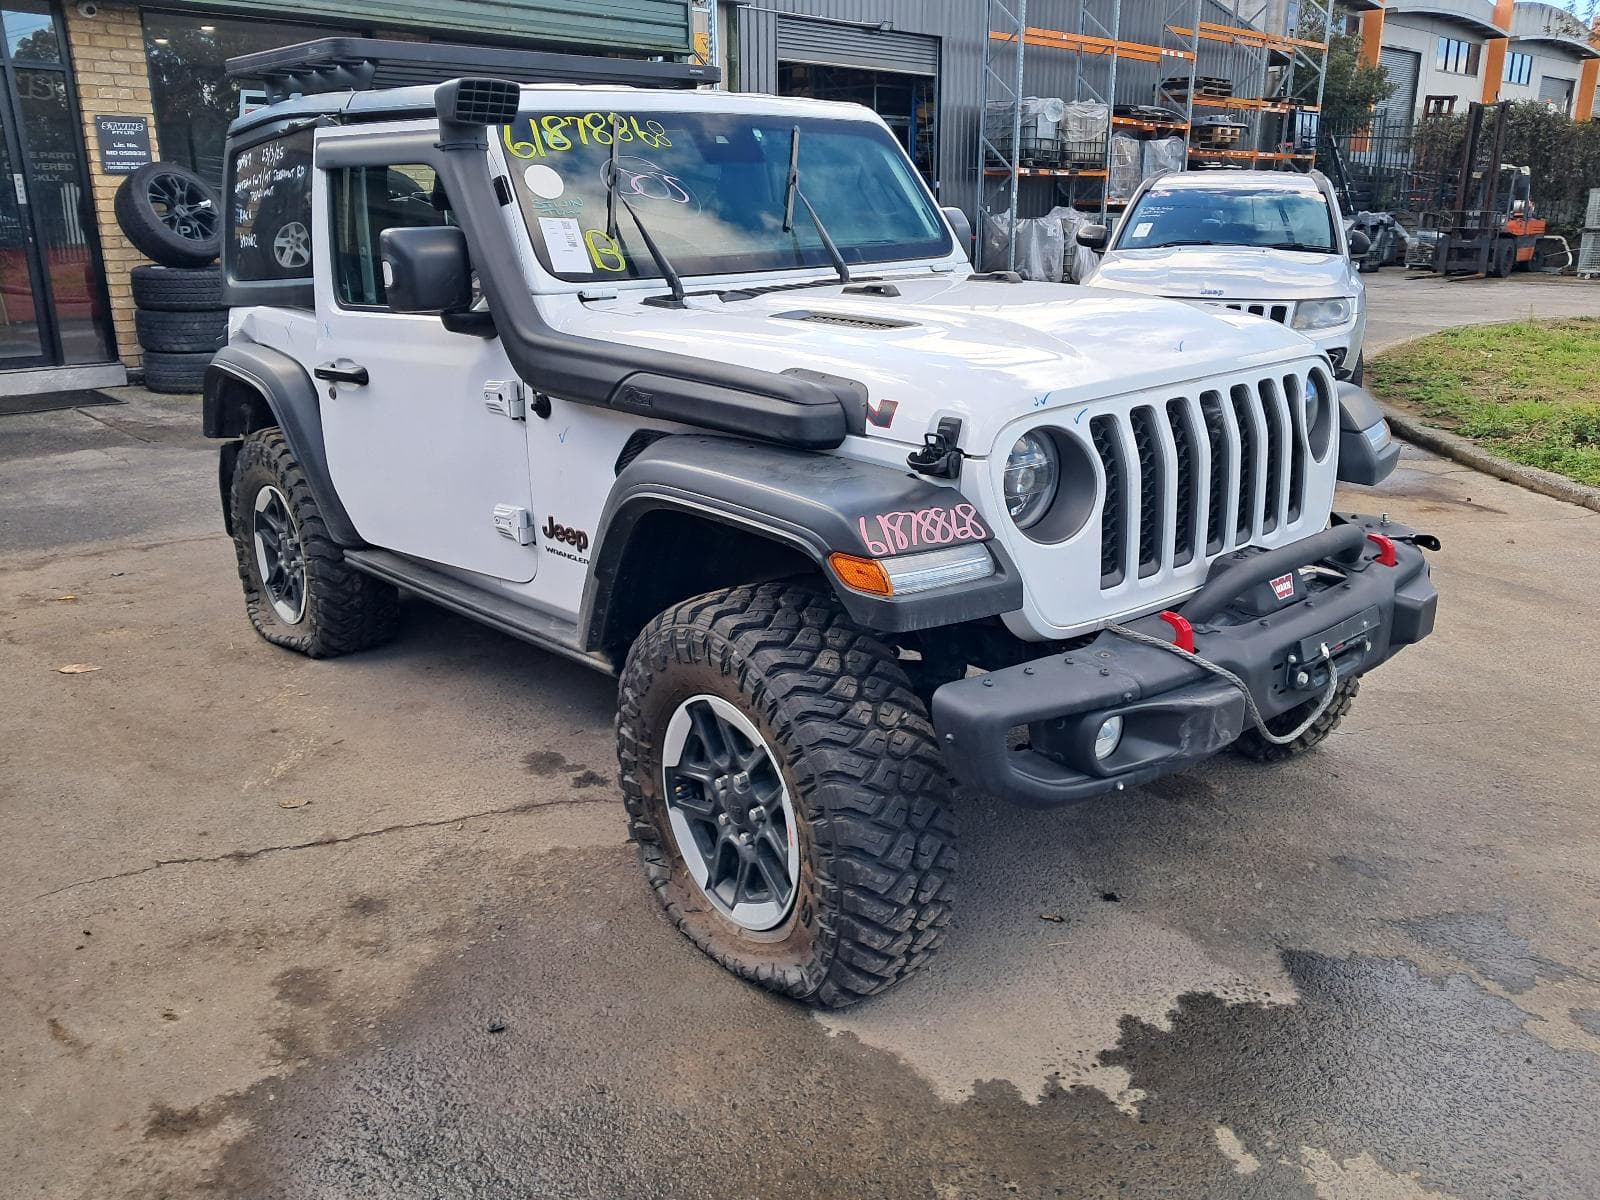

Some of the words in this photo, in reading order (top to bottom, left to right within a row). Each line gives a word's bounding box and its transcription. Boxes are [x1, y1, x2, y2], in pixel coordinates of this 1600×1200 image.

[504, 111, 672, 159] 61878868
[585, 229, 626, 272] B
[541, 516, 588, 553] Jeep
[858, 503, 987, 556] 61878868
[545, 545, 590, 564] WRANGLER
